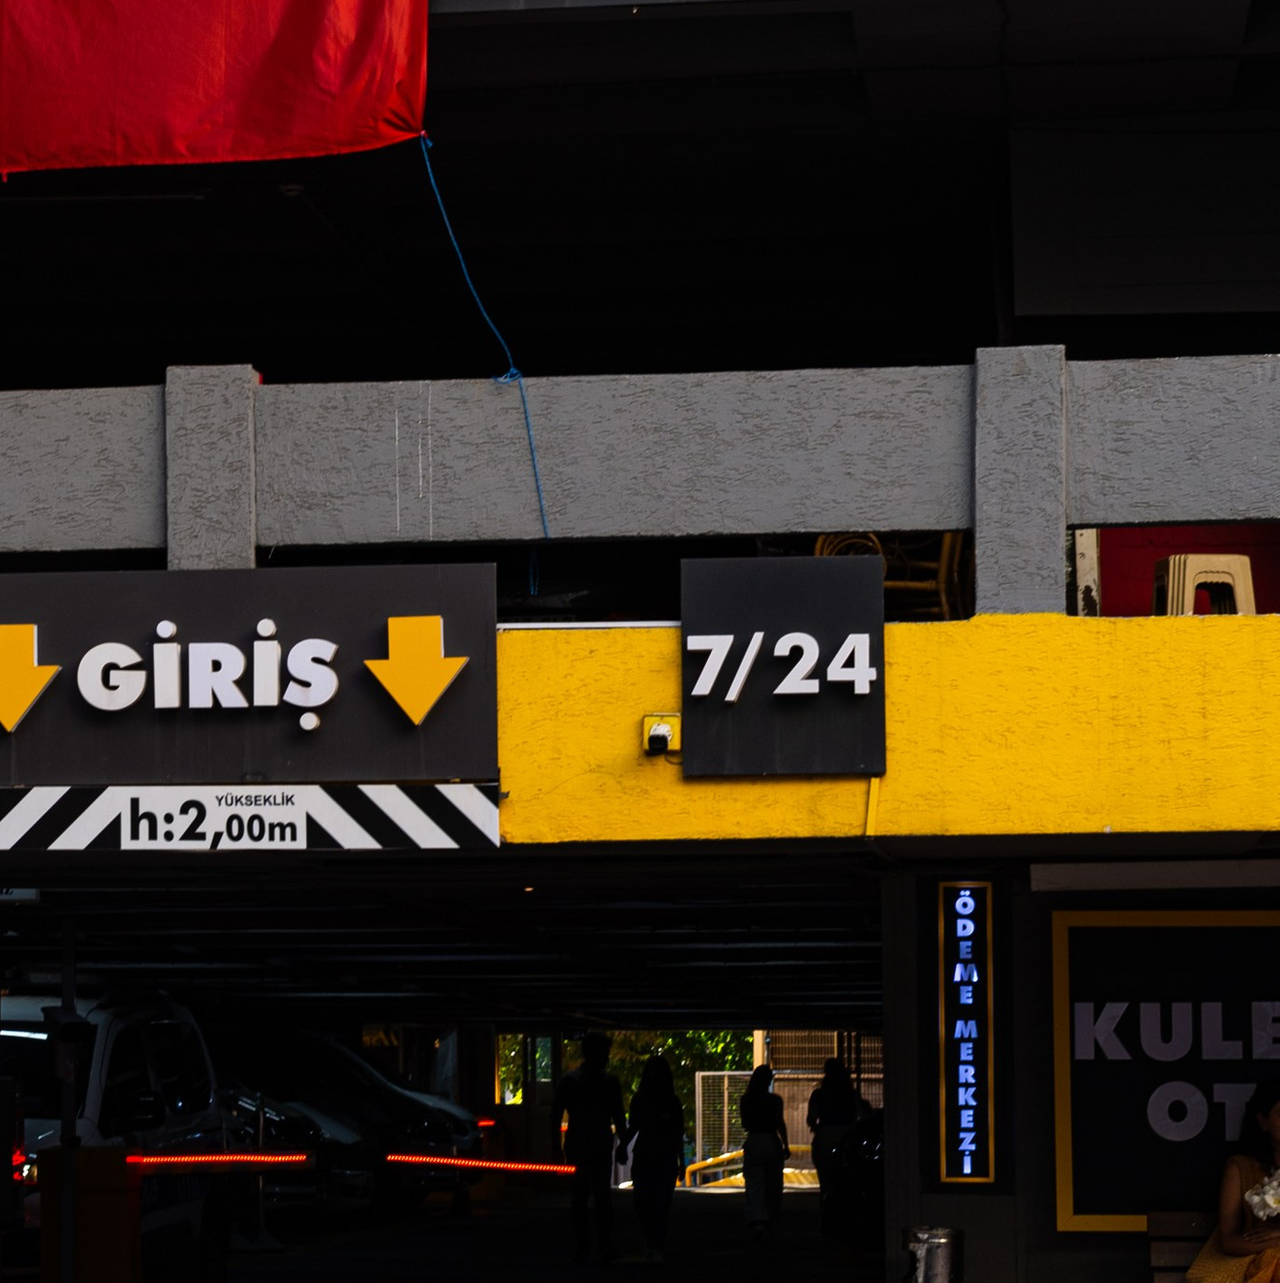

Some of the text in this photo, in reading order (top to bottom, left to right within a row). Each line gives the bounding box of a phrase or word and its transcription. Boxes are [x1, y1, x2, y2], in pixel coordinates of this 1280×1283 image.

[77, 618, 339, 731] GİRİŞ
[687, 631, 877, 703] 7/24
[130, 797, 297, 850] h:2,00m
[215, 792, 296, 806] YÜKSEKLİK
[954, 890, 978, 1174] ÖDEME MERKEZİ
